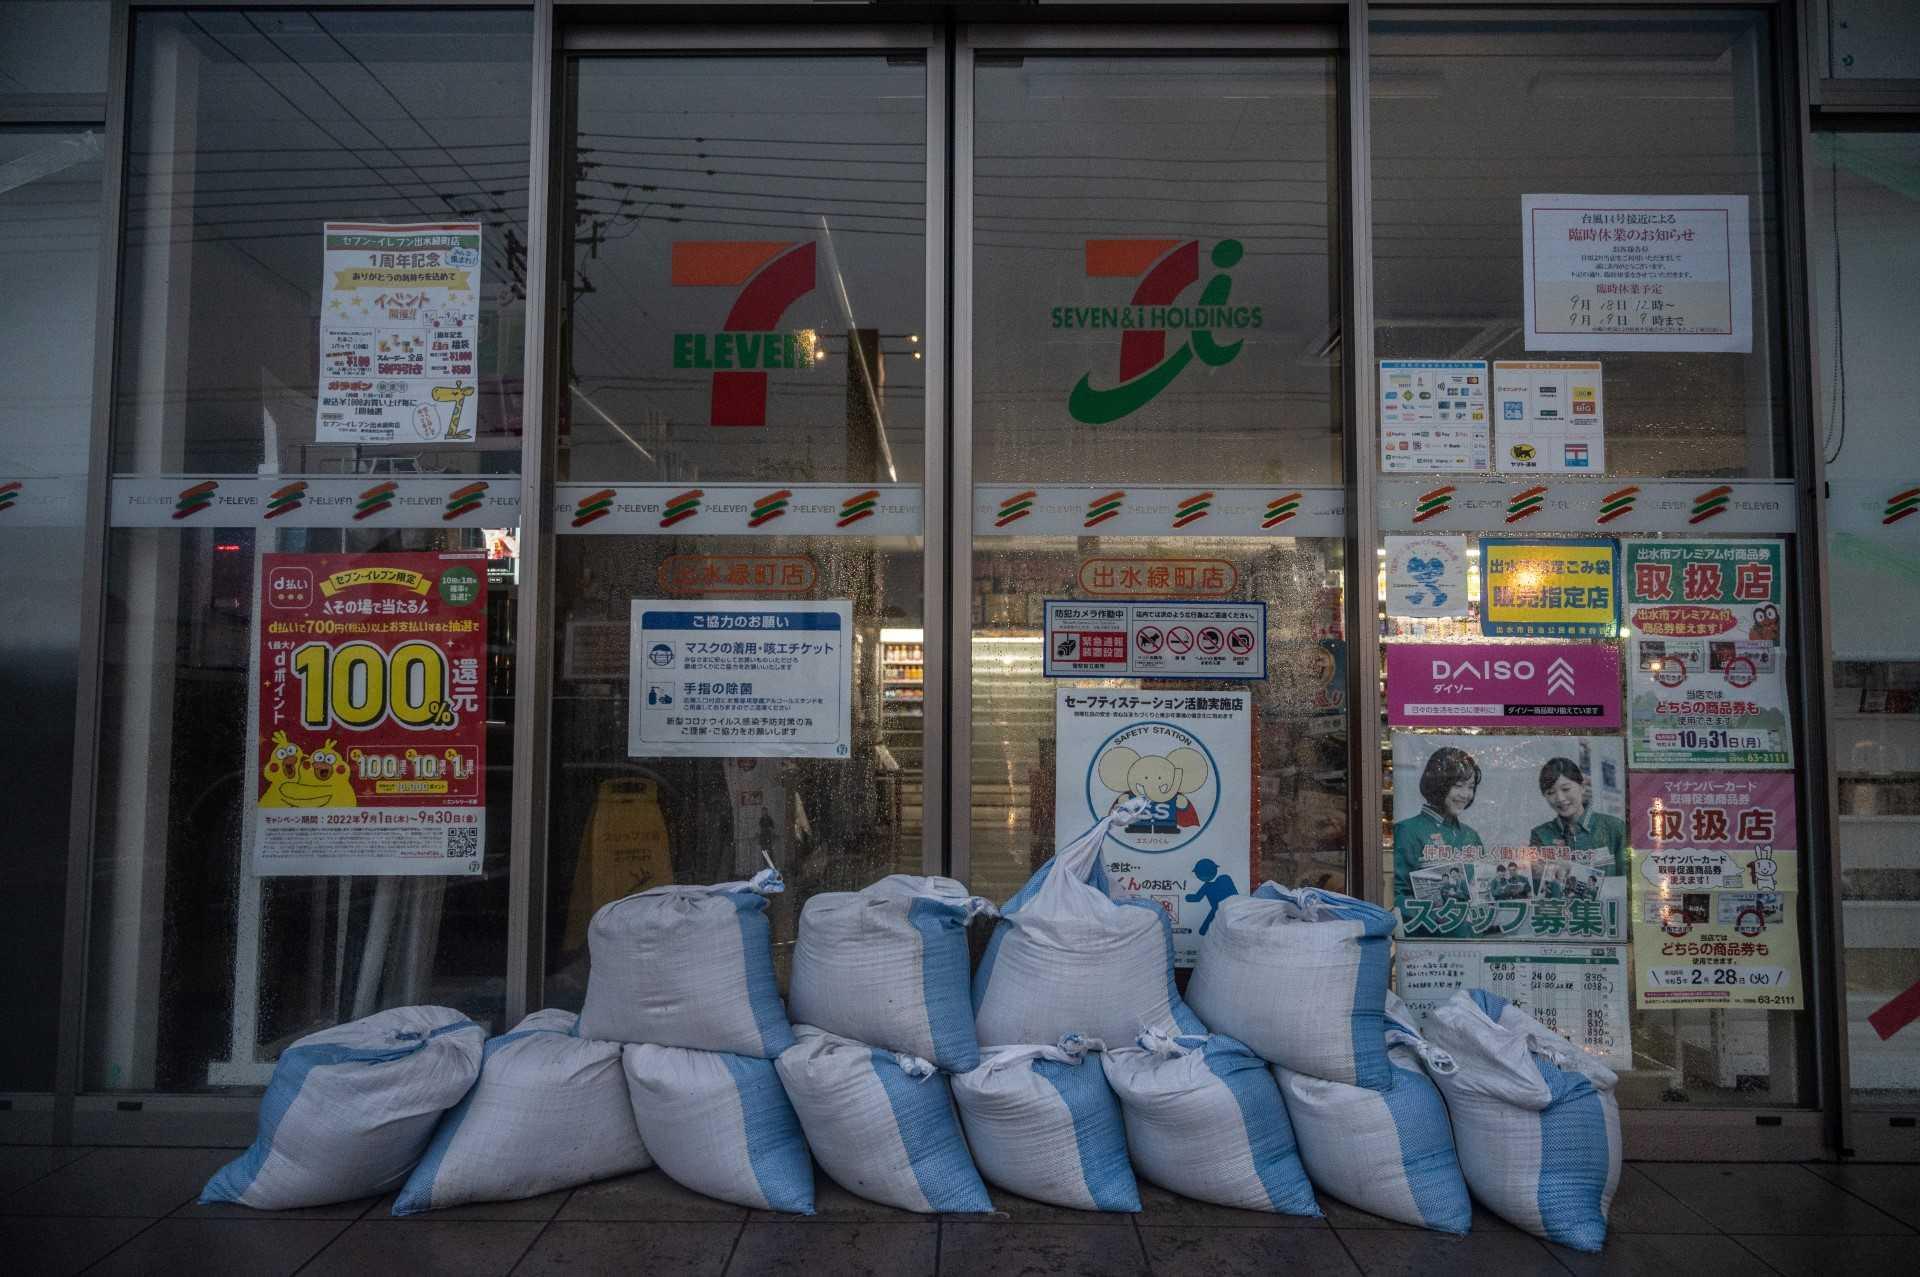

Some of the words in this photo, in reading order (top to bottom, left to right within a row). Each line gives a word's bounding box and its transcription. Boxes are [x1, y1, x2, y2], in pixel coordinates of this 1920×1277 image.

[1582, 213, 1675, 226] 台風14号接近による
[1568, 228, 1696, 243] 臨時休業のお知らせ
[369, 253, 440, 269] 1周年記念
[1596, 283, 1664, 295] 臨時休業予定
[1151, 307, 1264, 329] HOLDINGS
[1637, 548, 1771, 561] 出水市プレミアム付商品券
[273, 576, 309, 591] d払い
[1093, 566, 1225, 589] 出水緑町店
[1634, 562, 1773, 601] 取扱店
[332, 600, 419, 616] その場で当たる
[1055, 609, 1124, 619] 防犯カメラ作動中
[693, 614, 790, 629] ご協力のお願い
[686, 642, 834, 656] マスクの着用・咳エチケット
[1432, 660, 1535, 681] DAISO
[273, 652, 287, 726] dポイント
[452, 658, 480, 713] 還元
[683, 682, 753, 695] 手指の除菌
[1432, 683, 1474, 695] ダイソー
[1687, 690, 1722, 699] 当店では
[1065, 695, 1244, 712] セーフティステーション活動実施店
[1655, 701, 1760, 715] どちらの商品券も
[1114, 727, 1150, 747] SAFETY
[1153, 727, 1192, 747] STATION
[1678, 730, 1761, 749] 10月31日(月)
[1664, 781, 1757, 793] マイナンバーカード
[1650, 809, 1775, 841] 取扱店
[1651, 855, 1727, 865] マイナンバーカード
[1658, 865, 1722, 876] 取得促進商品券
[1404, 897, 1618, 939] スタッフ募集!
[1662, 942, 1769, 956] どちらの商品券も
[1758, 995, 1795, 1005] 63-2111
